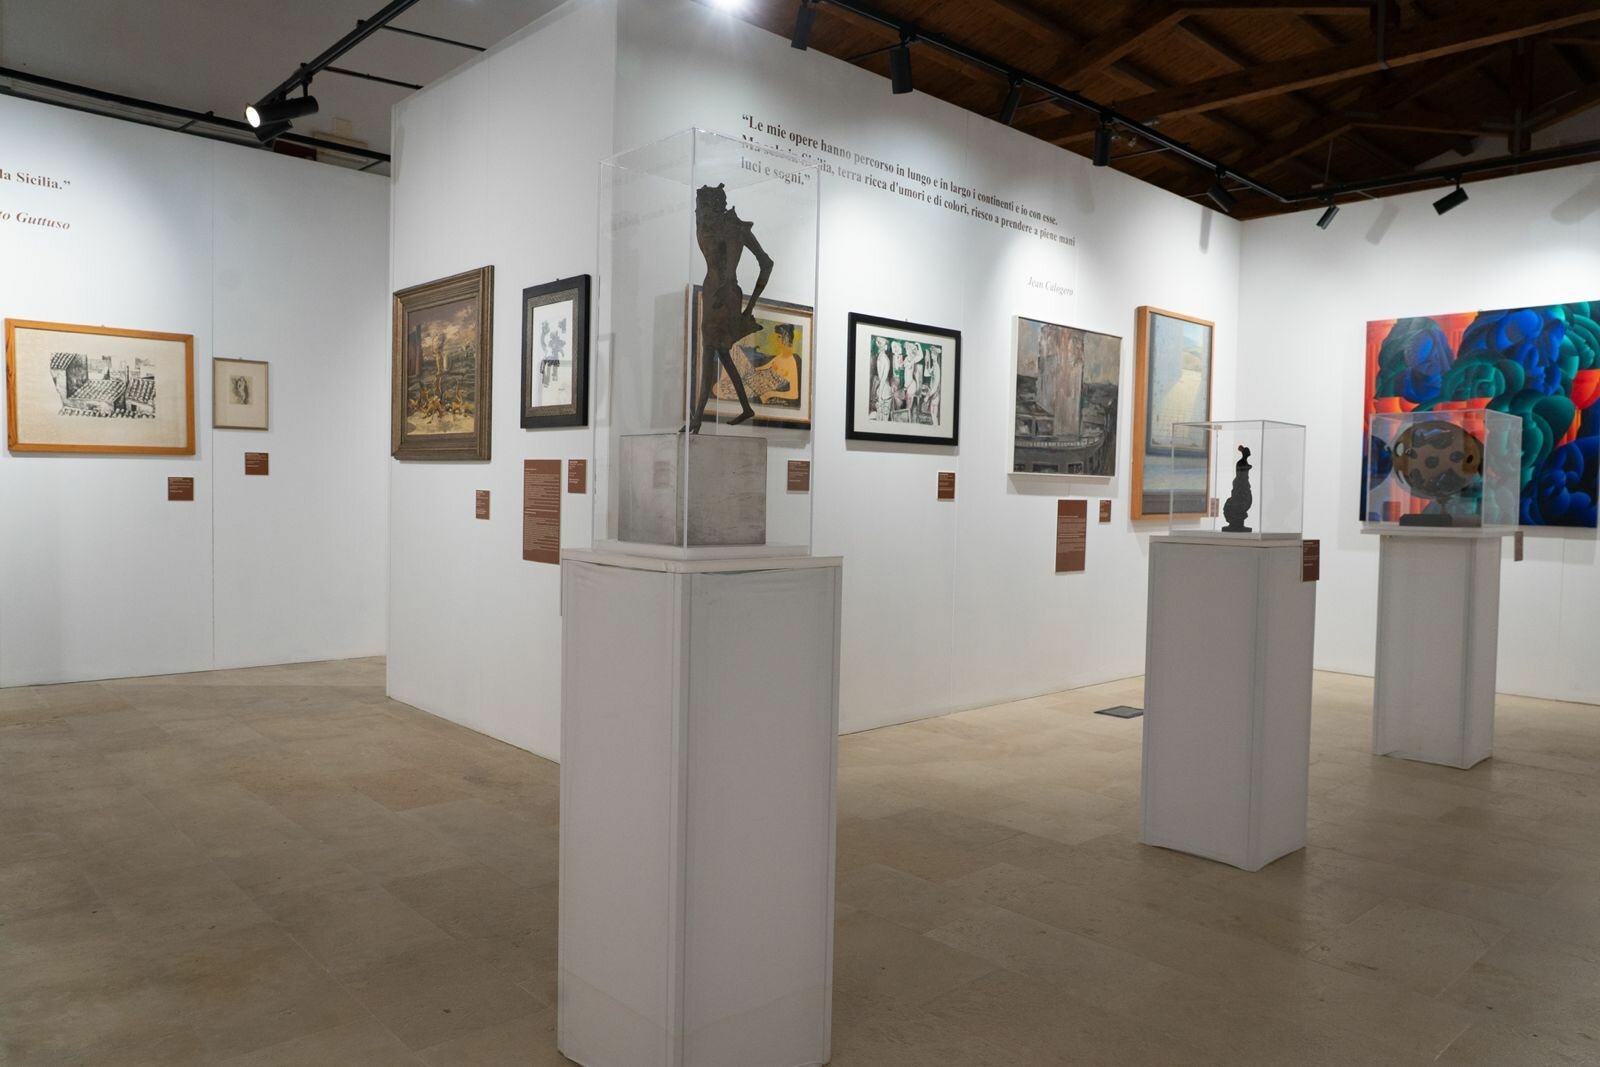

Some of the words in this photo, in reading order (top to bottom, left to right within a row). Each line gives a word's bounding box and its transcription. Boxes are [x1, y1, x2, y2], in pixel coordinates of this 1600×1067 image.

[741, 156, 761, 174] luci
[764, 166, 770, 176] e
[766, 124, 787, 139] mie
[789, 131, 819, 149] opere
[820, 139, 851, 160] hanno
[854, 153, 894, 173] percorso
[896, 163, 905, 177] in
[907, 167, 932, 186] lungo
[933, 178, 939, 187] e
[940, 178, 948, 191] in
[950, 181, 971, 199] largo
[972, 188, 976, 200] i
[977, 193, 1014, 212] continenti
[1015, 205, 1020, 213] e
[1021, 204, 1028, 217] io
[1029, 209, 1041, 220] con
[1042, 213, 1058, 226] esse.
[837, 165, 862, 183] terra
[864, 174, 887, 190] ricca
[926, 194, 932, 203] e
[933, 194, 942, 207] di
[944, 200, 969, 215] colori,
[971, 206, 993, 222] riesco
[994, 215, 999, 224] a
[1001, 217, 1032, 234] prendere
[1039, 227, 1057, 242] piene
[1059, 234, 1076, 247] mani
[16, 211, 71, 230] Guttuso
[1027, 276, 1044, 289] Jean
[1045, 278, 1074, 296] Calogero
